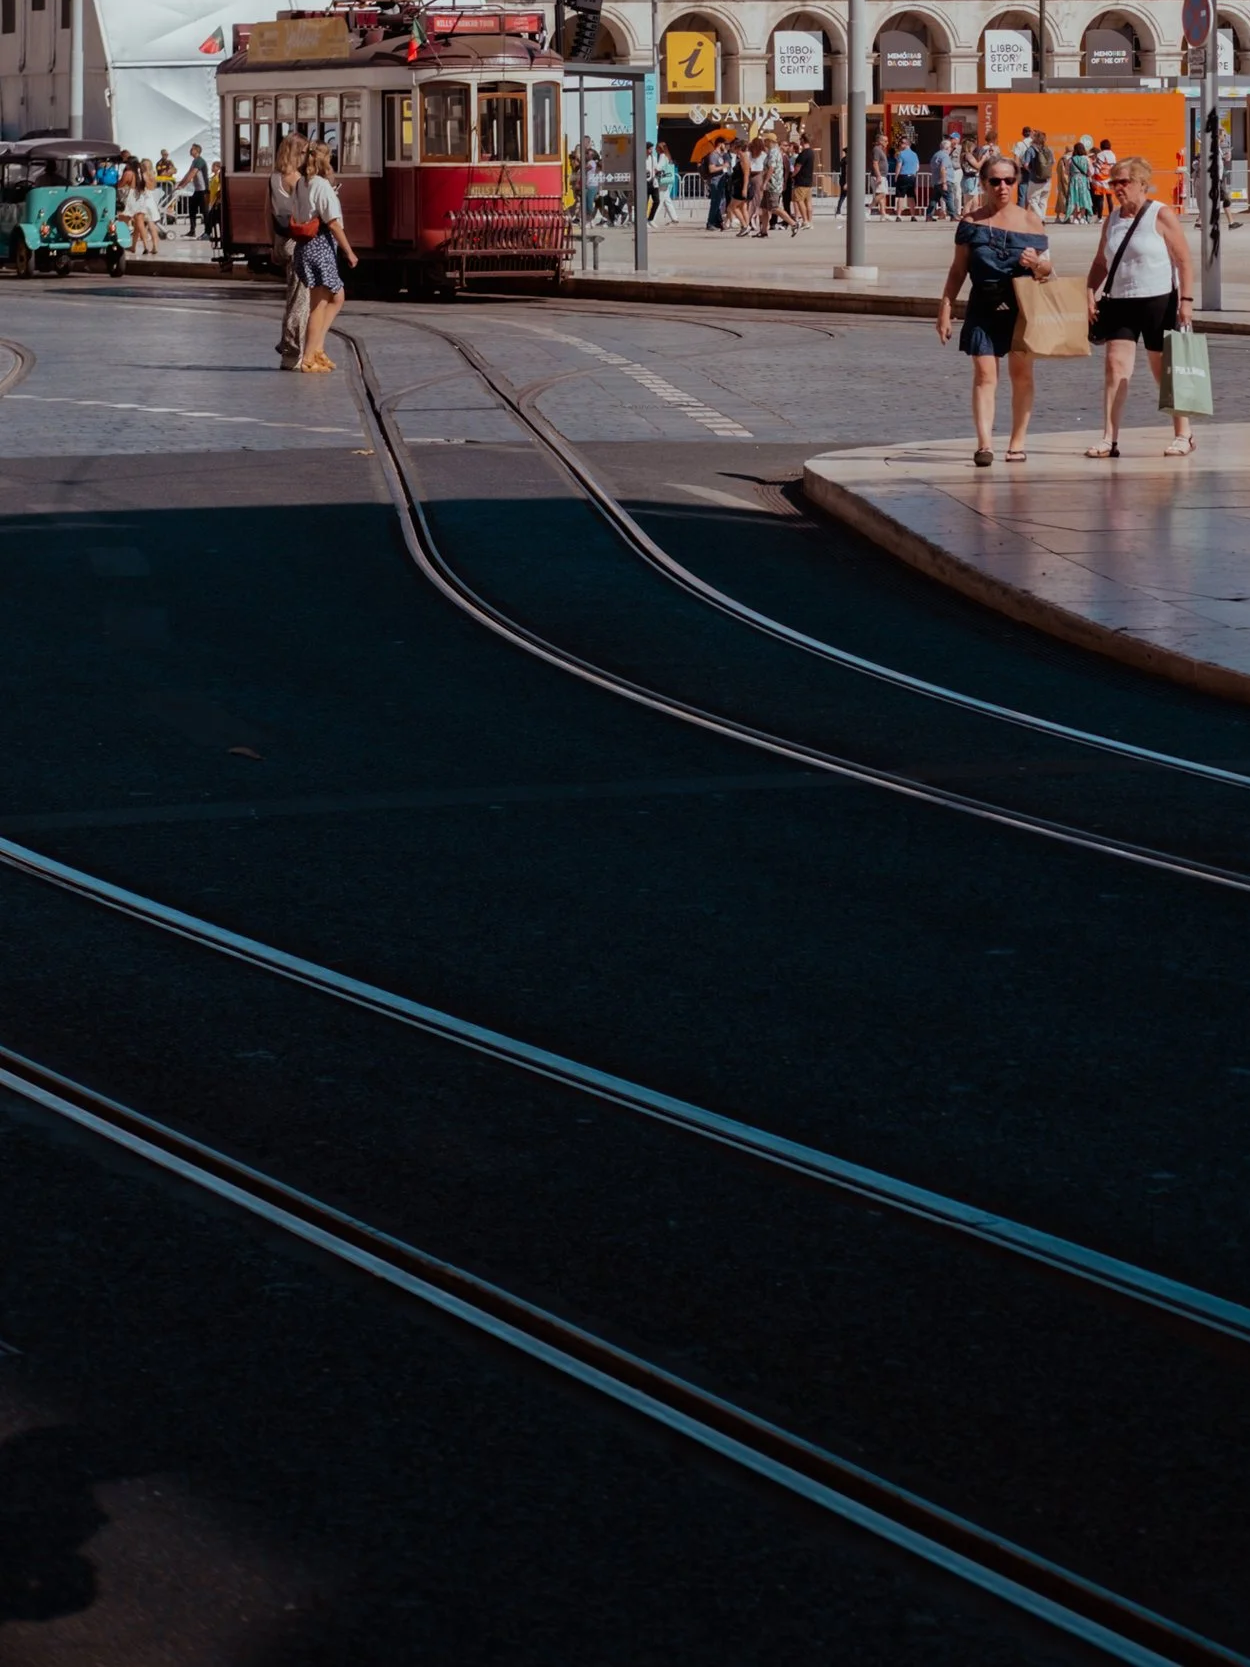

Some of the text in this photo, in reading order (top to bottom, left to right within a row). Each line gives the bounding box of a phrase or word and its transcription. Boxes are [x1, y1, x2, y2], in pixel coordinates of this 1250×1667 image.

[780, 56, 812, 64] STORY
[991, 54, 1022, 62] STORY
[780, 65, 819, 75] CENTRE
[990, 63, 1029, 73] CENTRE
[711, 105, 781, 123] SANDS
